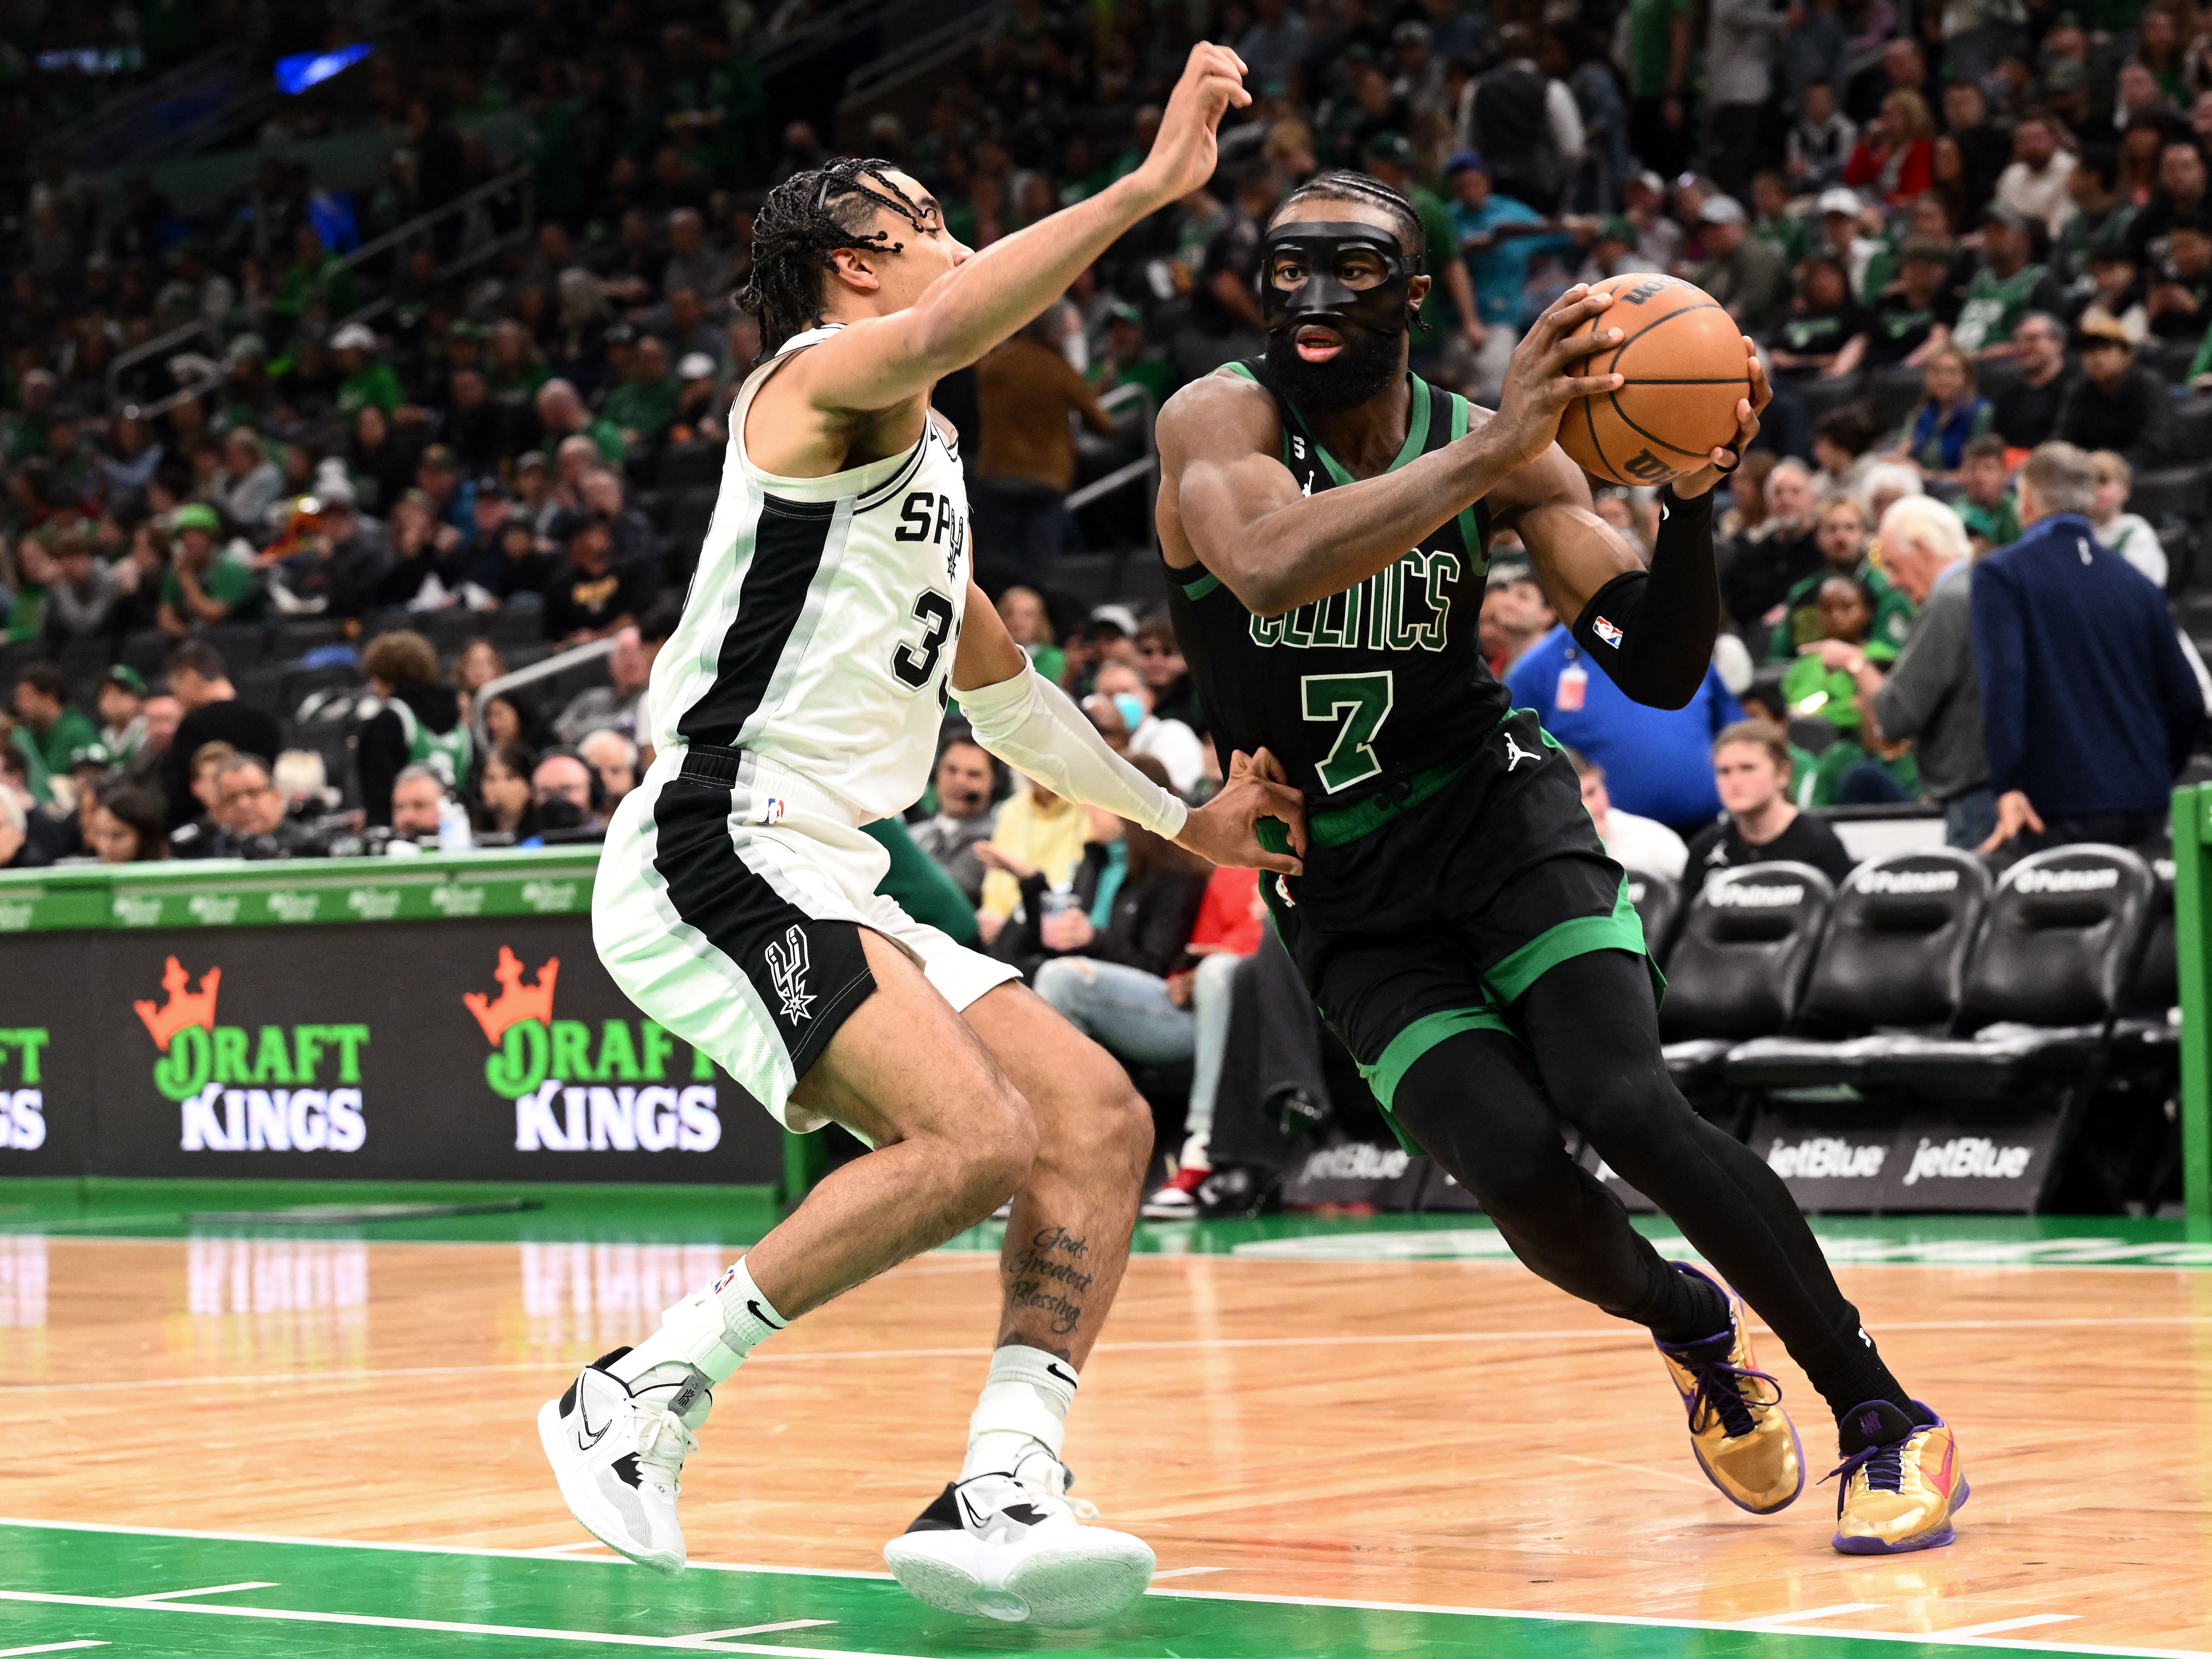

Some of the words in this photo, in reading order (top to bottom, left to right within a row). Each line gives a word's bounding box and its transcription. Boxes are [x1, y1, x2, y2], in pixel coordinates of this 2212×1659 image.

[1293, 435, 1305, 460] 6
[890, 586, 962, 715] 3
[1301, 670, 1393, 795] 7
[0, 1027, 50, 1085] T
[154, 1023, 370, 1102] DRAFT
[180, 1083, 367, 1152] KINGS
[515, 1080, 722, 1152] KINGS
[1902, 1137, 2032, 1186] jetBlue
